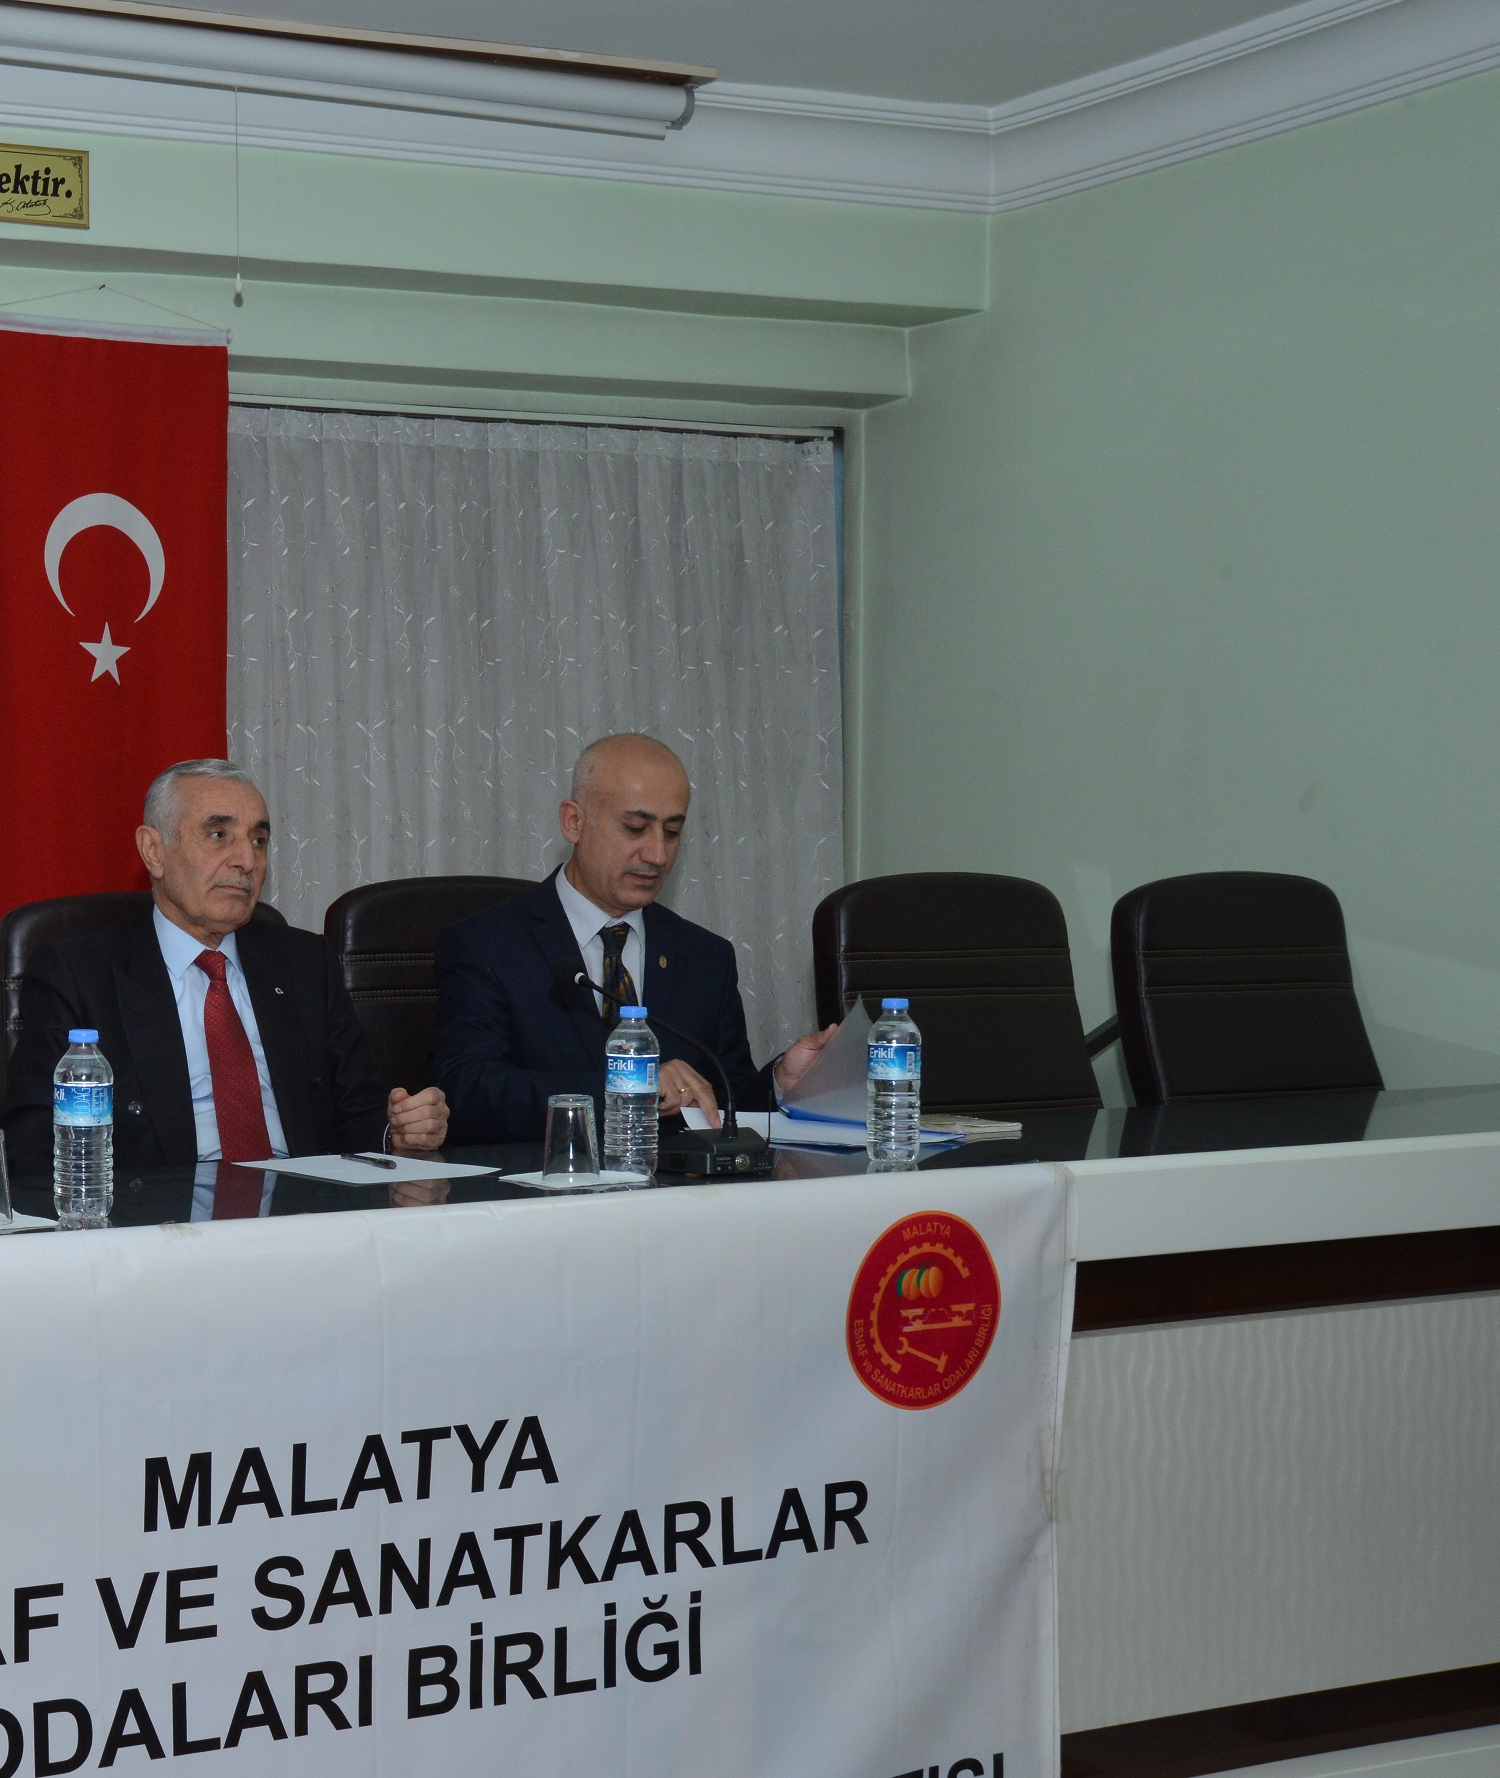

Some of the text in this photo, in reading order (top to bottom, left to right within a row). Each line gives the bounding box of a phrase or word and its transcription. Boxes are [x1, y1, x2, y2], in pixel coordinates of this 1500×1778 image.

[607, 1058, 634, 1071] Erikli
[869, 1047, 893, 1059] Erikli
[902, 1222, 951, 1241] MALATYA
[854, 1319, 866, 1358] ESNAF
[862, 1358, 873, 1374] ve
[870, 1368, 941, 1400] SANATKARLAR
[942, 1350, 981, 1390] ODALARI
[143, 1415, 560, 1533] MALATYA
[97, 1564, 218, 1650] VE
[250, 1480, 869, 1631] SANATKARLAR
[407, 1590, 702, 1720] BİRLİĞİ
